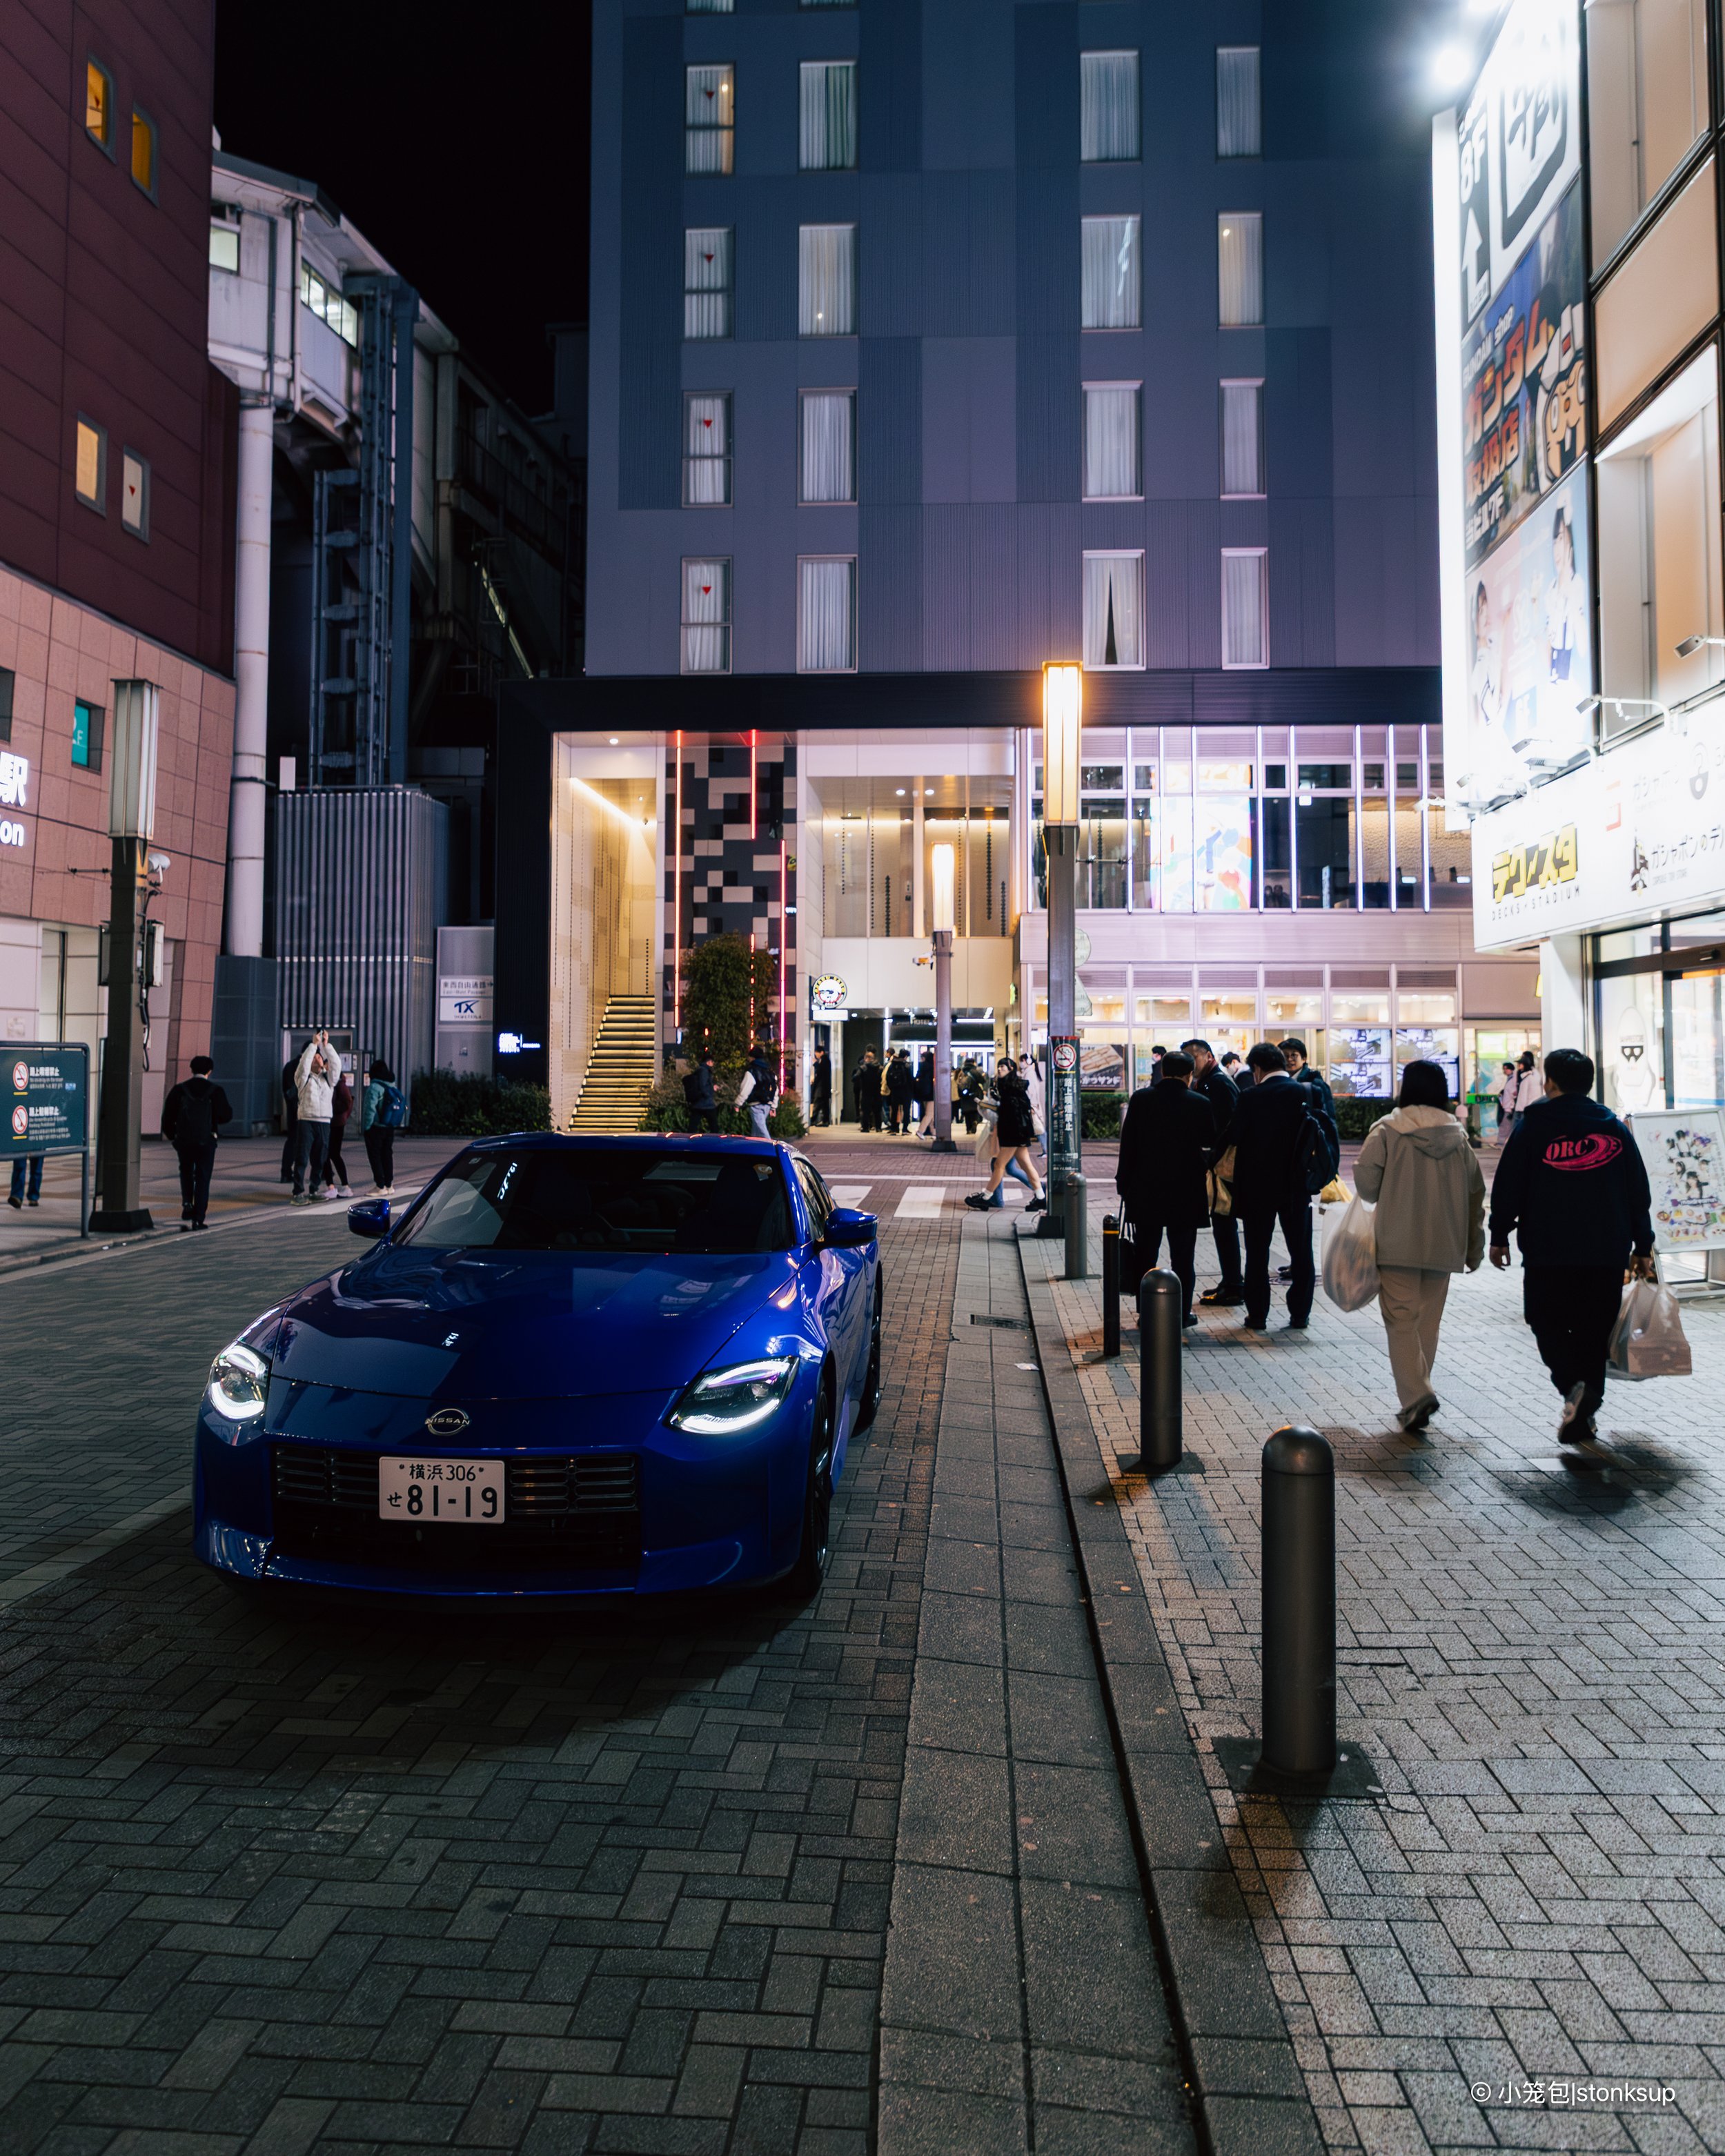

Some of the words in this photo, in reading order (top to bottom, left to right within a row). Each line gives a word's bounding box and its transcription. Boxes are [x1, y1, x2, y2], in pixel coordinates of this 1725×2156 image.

[1461, 112, 1487, 204] 8F
[1464, 299, 1548, 456] ガンダム
[0, 751, 28, 807] 駅
[0, 818, 24, 847] on
[1651, 824, 1725, 870] ガシャポンのデ
[1492, 902, 1520, 922] DECKS
[1532, 885, 1580, 910] STADIUM
[454, 999, 480, 1013] TX
[1080, 1076, 1121, 1085] かつサンド
[386, 1492, 403, 1507] せ
[407, 1484, 497, 1519] 81-19
